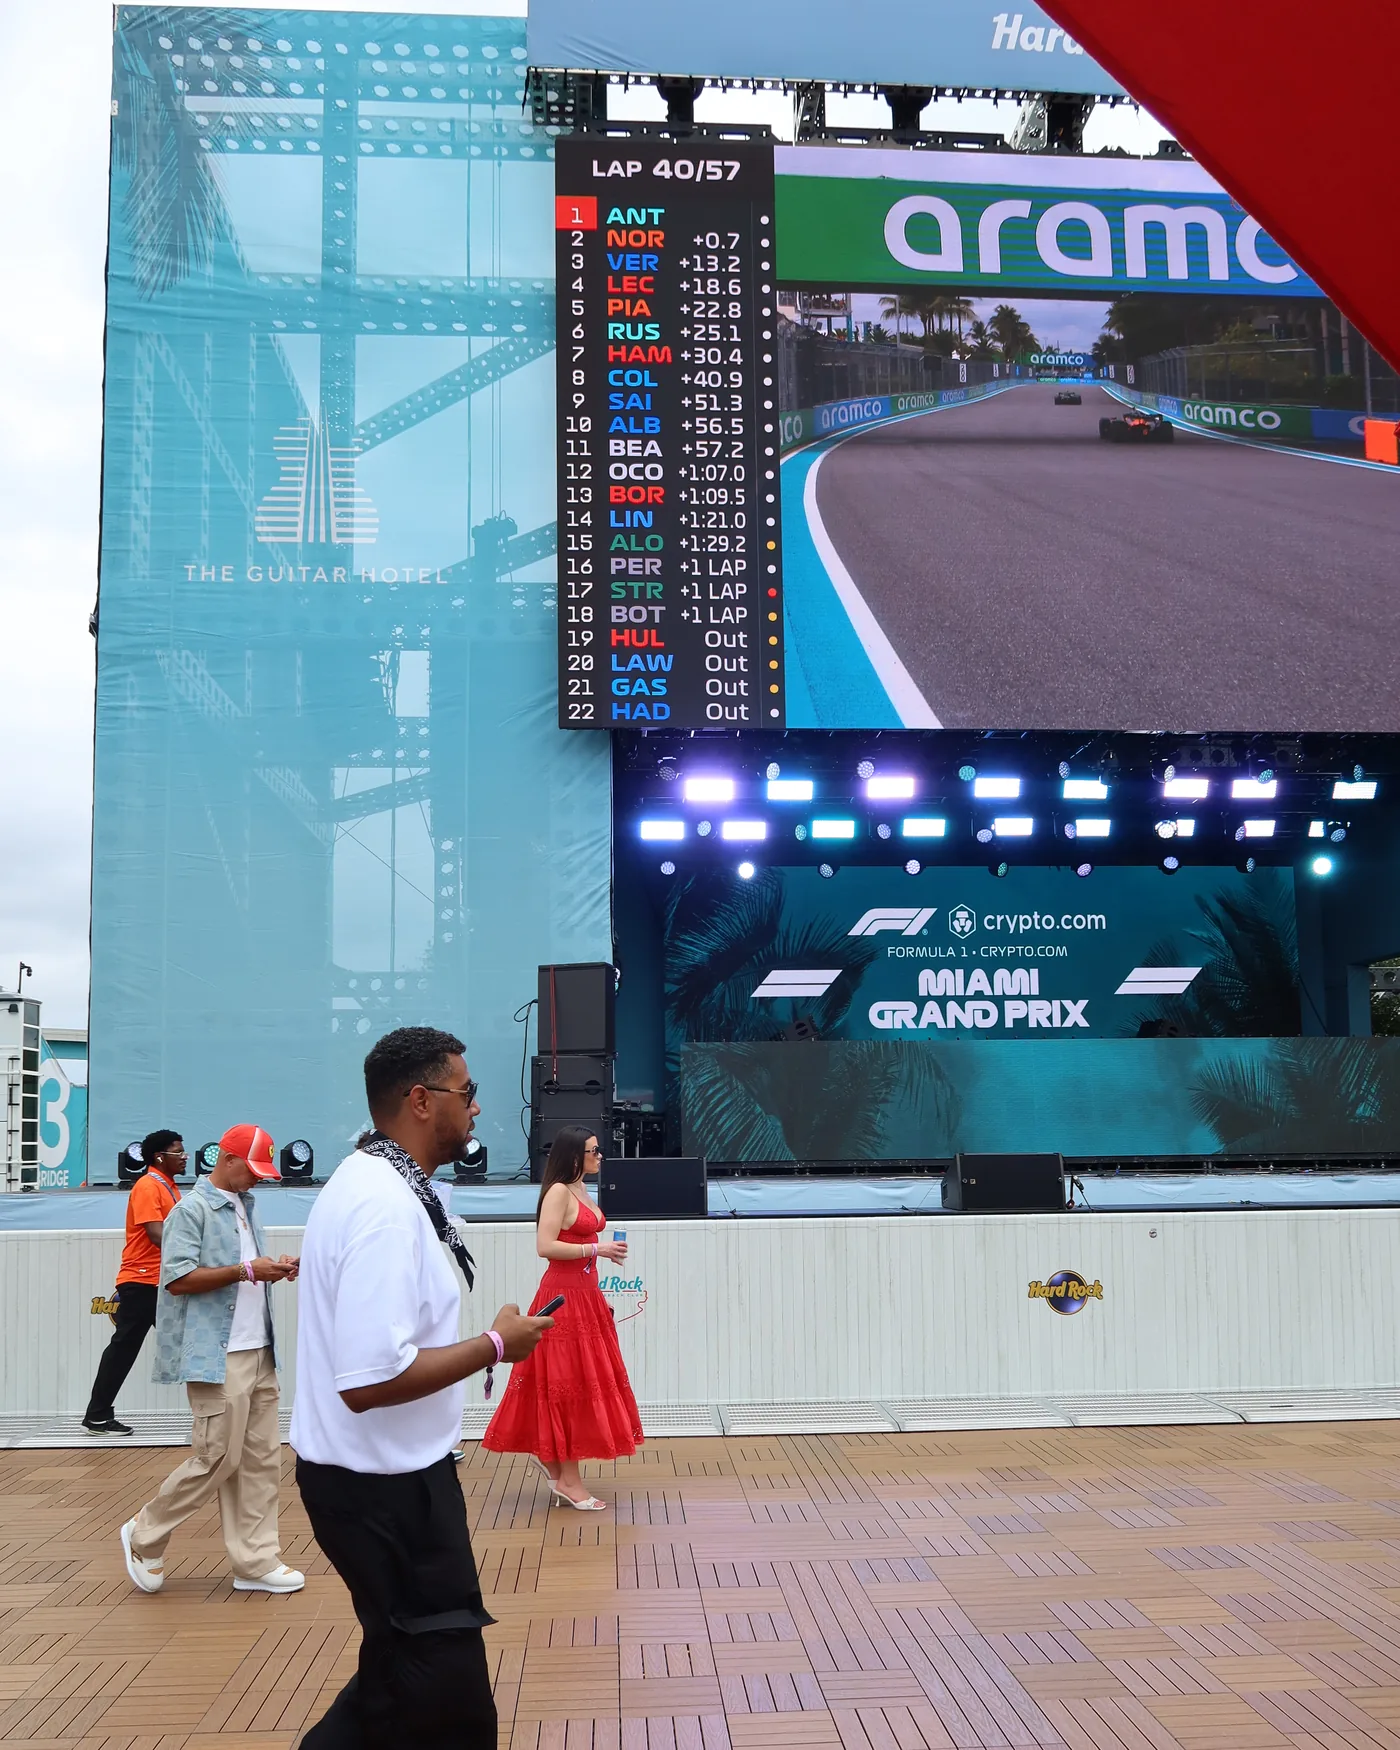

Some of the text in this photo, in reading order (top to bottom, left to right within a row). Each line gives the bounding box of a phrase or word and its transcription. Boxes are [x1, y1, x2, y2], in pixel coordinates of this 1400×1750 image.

[592, 159, 741, 182] LAP 40/57
[571, 208, 665, 225] 1 ANT
[572, 229, 739, 249] 2 NOR +0.7
[883, 195, 1299, 284] aramc
[572, 253, 740, 272] 3 VER +13.2
[572, 276, 741, 295] 4 LEC +18.6
[572, 299, 741, 318] 5 PIA +22.8
[572, 323, 741, 341] 6 RUS +25.1
[573, 346, 743, 365] 7 HAM +30.4
[1030, 354, 1083, 365] aramco
[573, 369, 742, 388] 8 COL +40.9
[573, 393, 742, 411] 9 SAI +51.3
[898, 394, 935, 411] aramco
[821, 400, 882, 429] aramco
[1184, 403, 1281, 430] aramco
[567, 417, 743, 434] 10 ALB +56.5
[567, 440, 743, 458] 11 BEA +57.2
[567, 464, 745, 481] 12 OCO +1:07.0
[567, 487, 745, 505] 13 BOR +1:09.5
[567, 511, 746, 528] 14 LIN +1:21.0
[567, 534, 745, 552] 15 ALO +1:29.2
[184, 565, 448, 584] THE GUITAR HOTEL
[568, 558, 746, 576] 16 PER +1 LAP
[568, 582, 747, 599] 17 STR +1 LAP
[568, 606, 747, 623] 18 BOT +1 LAP
[568, 629, 747, 648] 19 HUL Out
[568, 654, 748, 672] 20 LAW Out
[568, 677, 748, 696] 21 GAS Out
[569, 701, 749, 720] 22 HAD Out
[848, 907, 1107, 936] F1 crypto.com
[887, 945, 1068, 958] FORMULA 1 CRYPTO.COM
[918, 968, 1039, 996] MIAMI
[868, 999, 1090, 1029] GRAND PRIX
[40, 1169, 69, 1187] RIDGE
[610, 1276, 643, 1292] Rock
[1028, 1280, 1103, 1300] Hard Rock
[91, 1297, 120, 1314] Har
